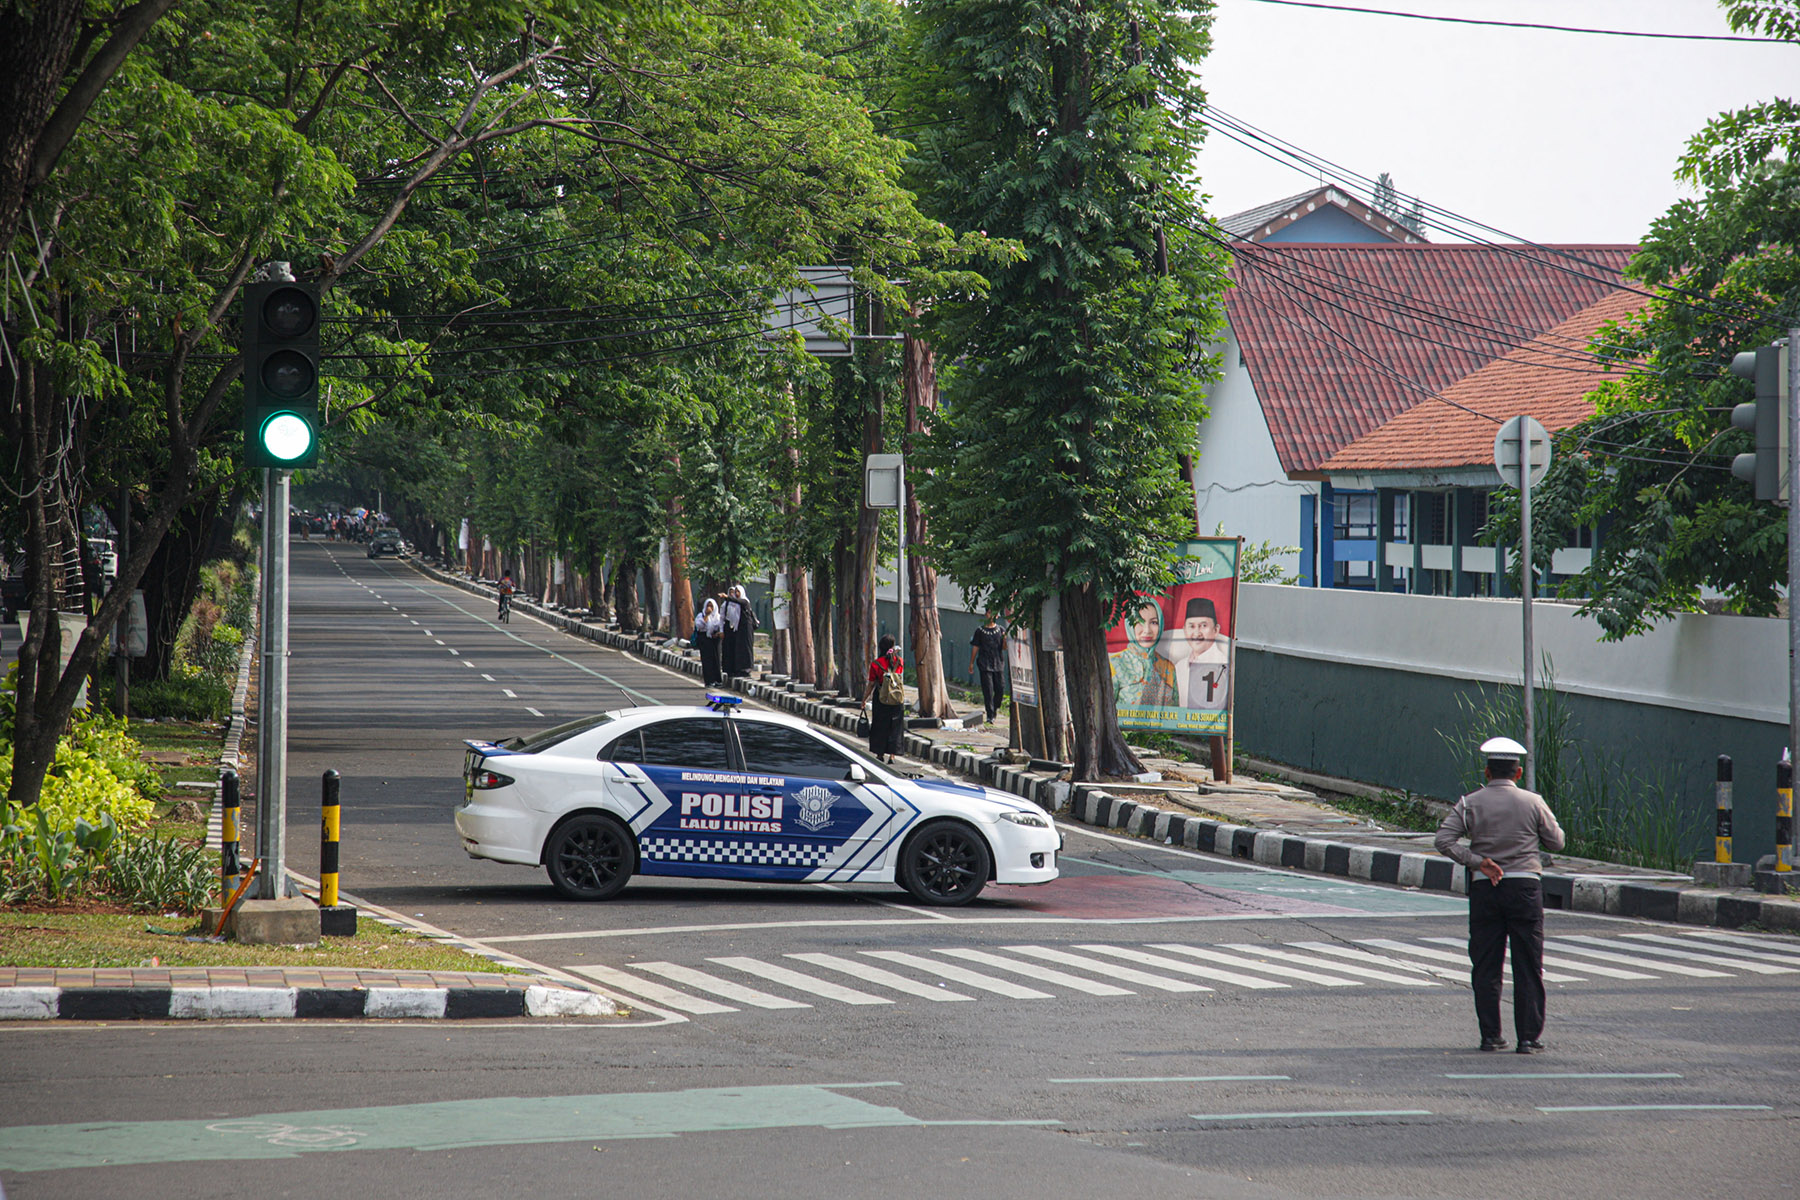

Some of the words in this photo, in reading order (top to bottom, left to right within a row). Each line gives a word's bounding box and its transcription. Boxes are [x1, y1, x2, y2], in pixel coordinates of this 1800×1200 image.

[1202, 671, 1214, 702] 1
[747, 776, 758, 784] DAN
[759, 777, 784, 786] MELAYANI
[681, 793, 783, 819] POLISI
[680, 818, 721, 830] LALU
[724, 820, 782, 832] LINTAS
